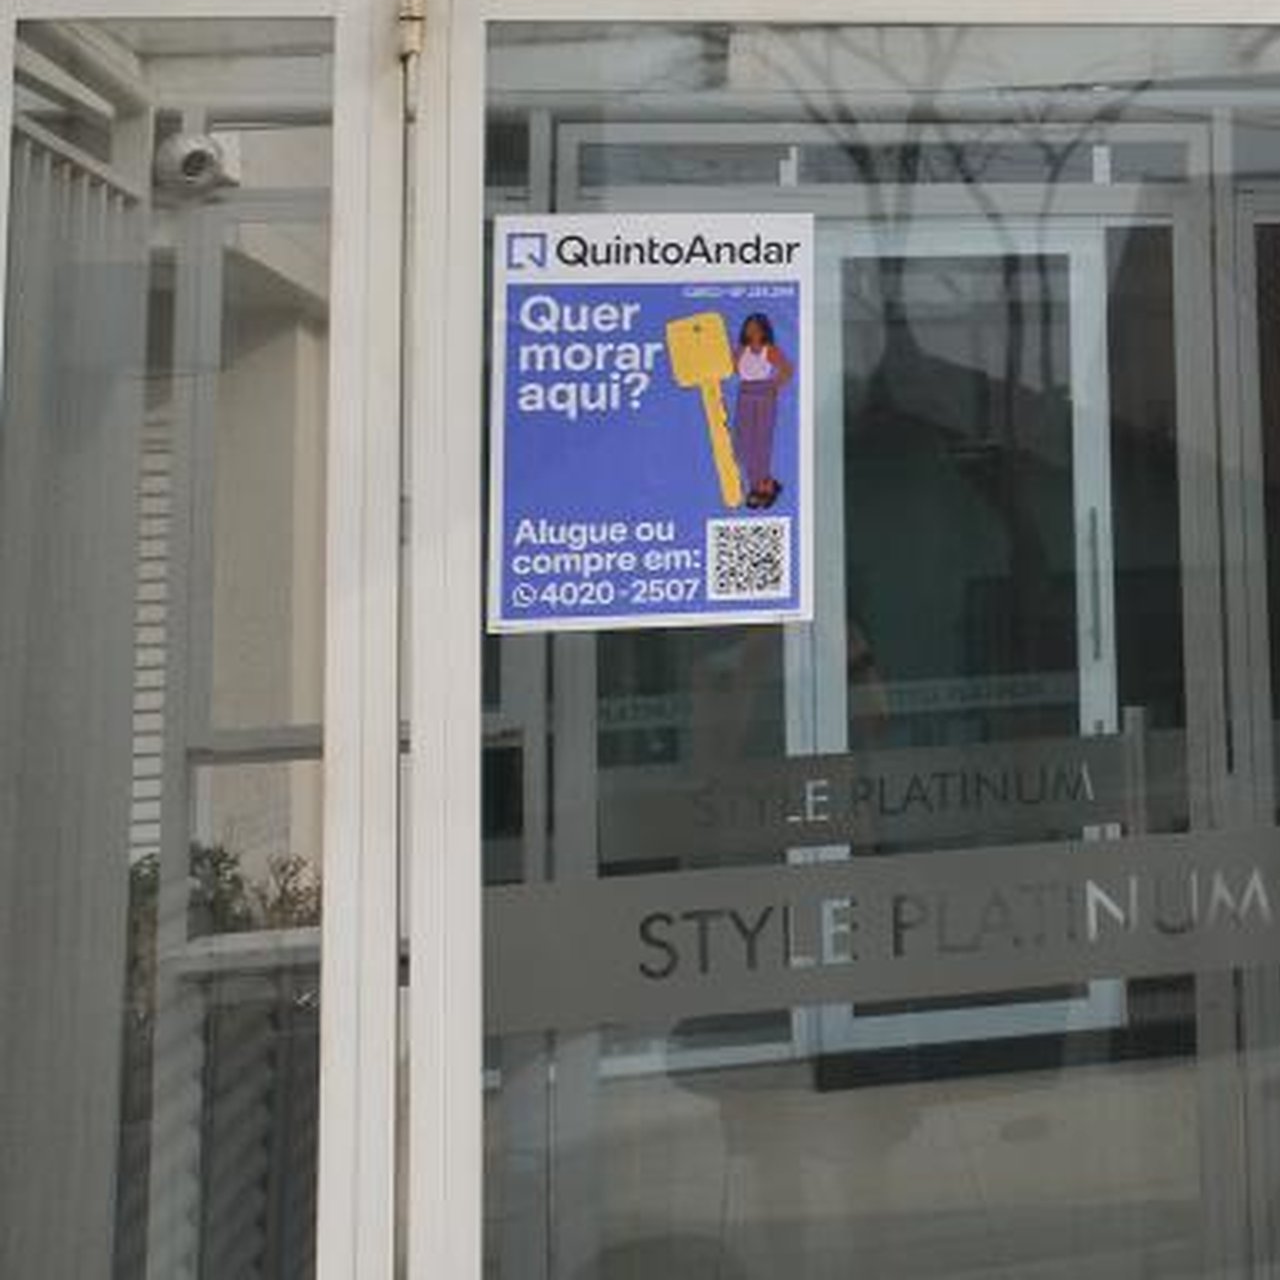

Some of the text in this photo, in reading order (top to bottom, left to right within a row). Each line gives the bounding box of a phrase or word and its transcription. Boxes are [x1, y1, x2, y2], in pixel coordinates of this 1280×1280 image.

[556, 234, 800, 267] QuintoAndar
[519, 294, 641, 334] Quer
[519, 340, 663, 372] morar
[518, 372, 650, 418] aqui?
[514, 518, 676, 550] Alugue ou
[512, 547, 702, 578] compre em:
[851, 760, 1094, 816] PLATINUM
[638, 867, 1273, 980] STYLE PLATINUM
